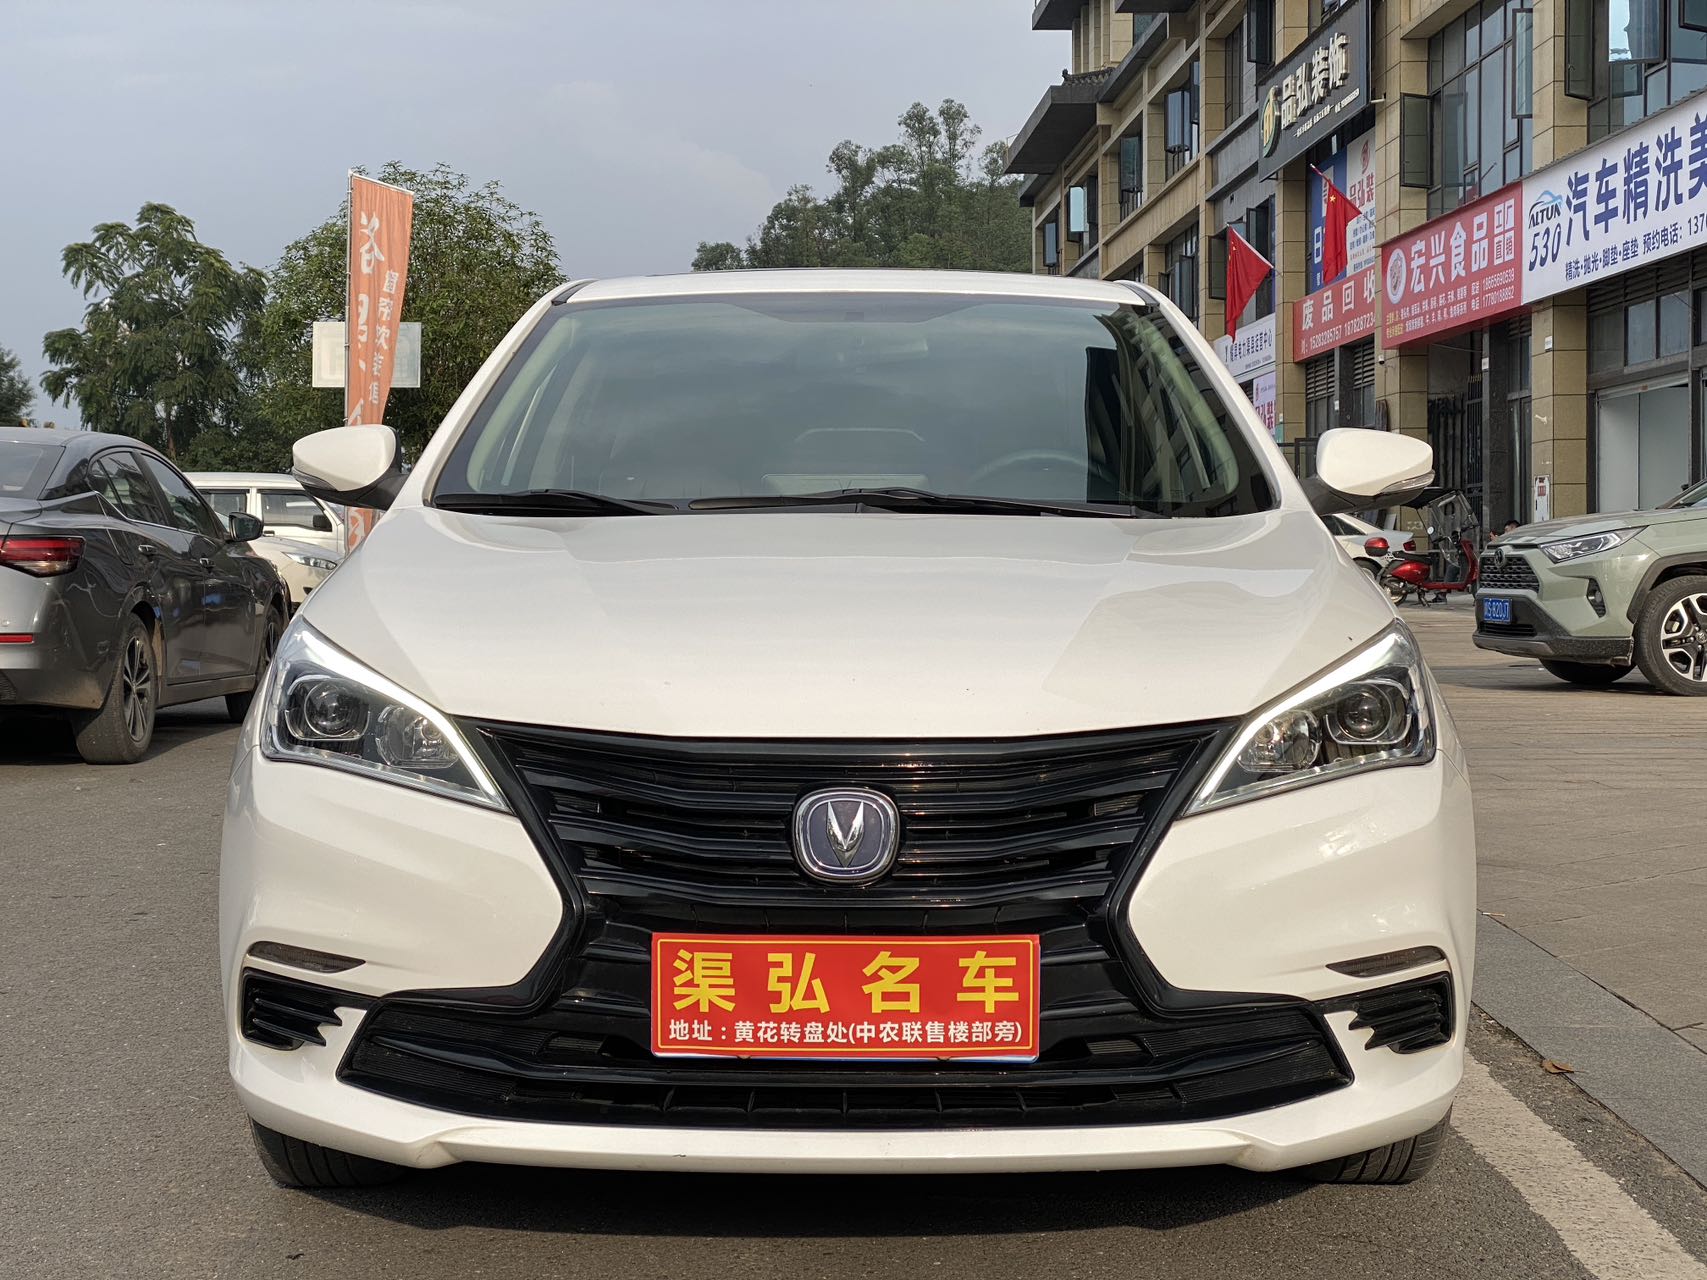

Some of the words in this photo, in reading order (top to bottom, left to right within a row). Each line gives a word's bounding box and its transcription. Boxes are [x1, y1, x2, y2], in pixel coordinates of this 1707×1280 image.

[1281, 32, 1349, 130] 品弘装饰
[1411, 212, 1488, 293] 宏兴食品
[1528, 222, 1562, 272] 530
[1643, 221, 1682, 255] 预约电话：
[1302, 269, 1376, 330] 废品回收
[673, 949, 1019, 1014] 渠弘名车
